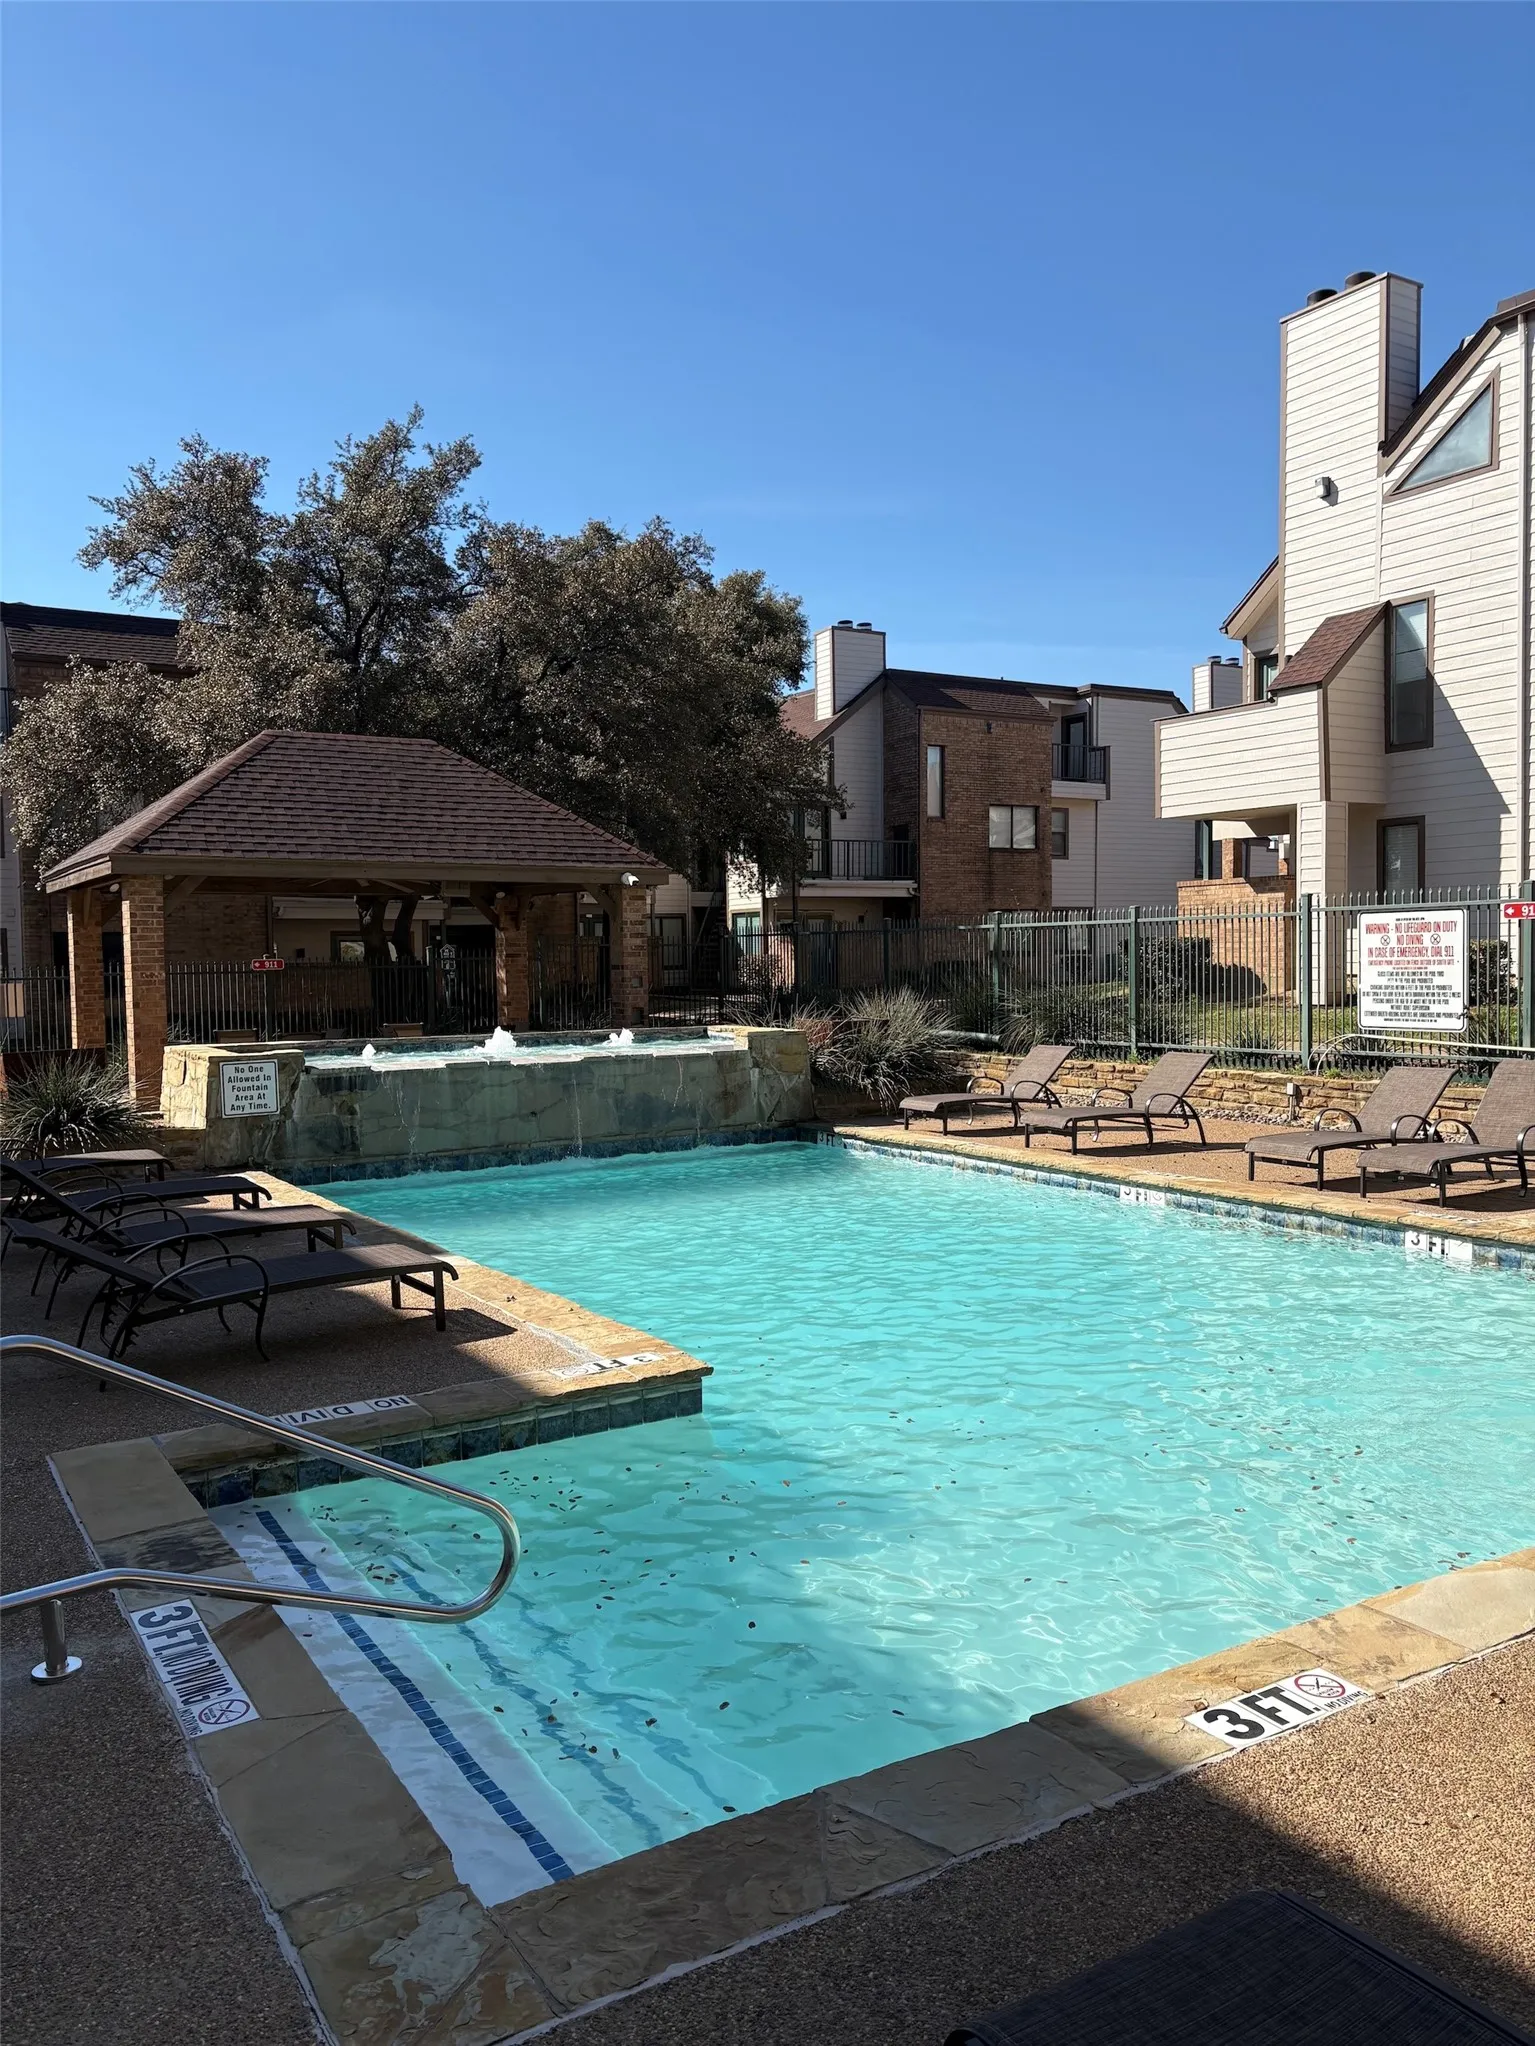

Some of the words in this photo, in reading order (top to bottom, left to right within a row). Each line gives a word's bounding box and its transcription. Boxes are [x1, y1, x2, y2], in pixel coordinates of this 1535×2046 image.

[1522, 905, 1535, 916] 91
[1366, 923, 1389, 934] WARNING
[1395, 922, 1402, 933] NO
[1404, 922, 1431, 933] LIFEGUARD
[1433, 921, 1441, 932] ON
[1443, 920, 1457, 932] DUTY
[1397, 934, 1404, 945] NO
[1406, 934, 1423, 945] DIVING
[1368, 947, 1373, 958] IN
[1375, 947, 1388, 958] CASE
[1389, 947, 1396, 958] OF
[1431, 946, 1442, 957] DIAL
[1444, 946, 1454, 957] 911
[228, 1075, 260, 1083] Allowed
[232, 1084, 268, 1092] Fountain
[230, 1104, 245, 1112] Any
[374, 1396, 410, 1408] NO
[275, 1406, 354, 1424] DIVI
[138, 1606, 194, 1628] 3
[160, 1646, 212, 1668] NO
[167, 1658, 233, 1706] DIVING
[1324, 1700, 1341, 1710] NO
[1336, 1690, 1370, 1705] DIVING
[183, 1716, 202, 1736] DIVING
[1204, 1708, 1265, 1739] 3
